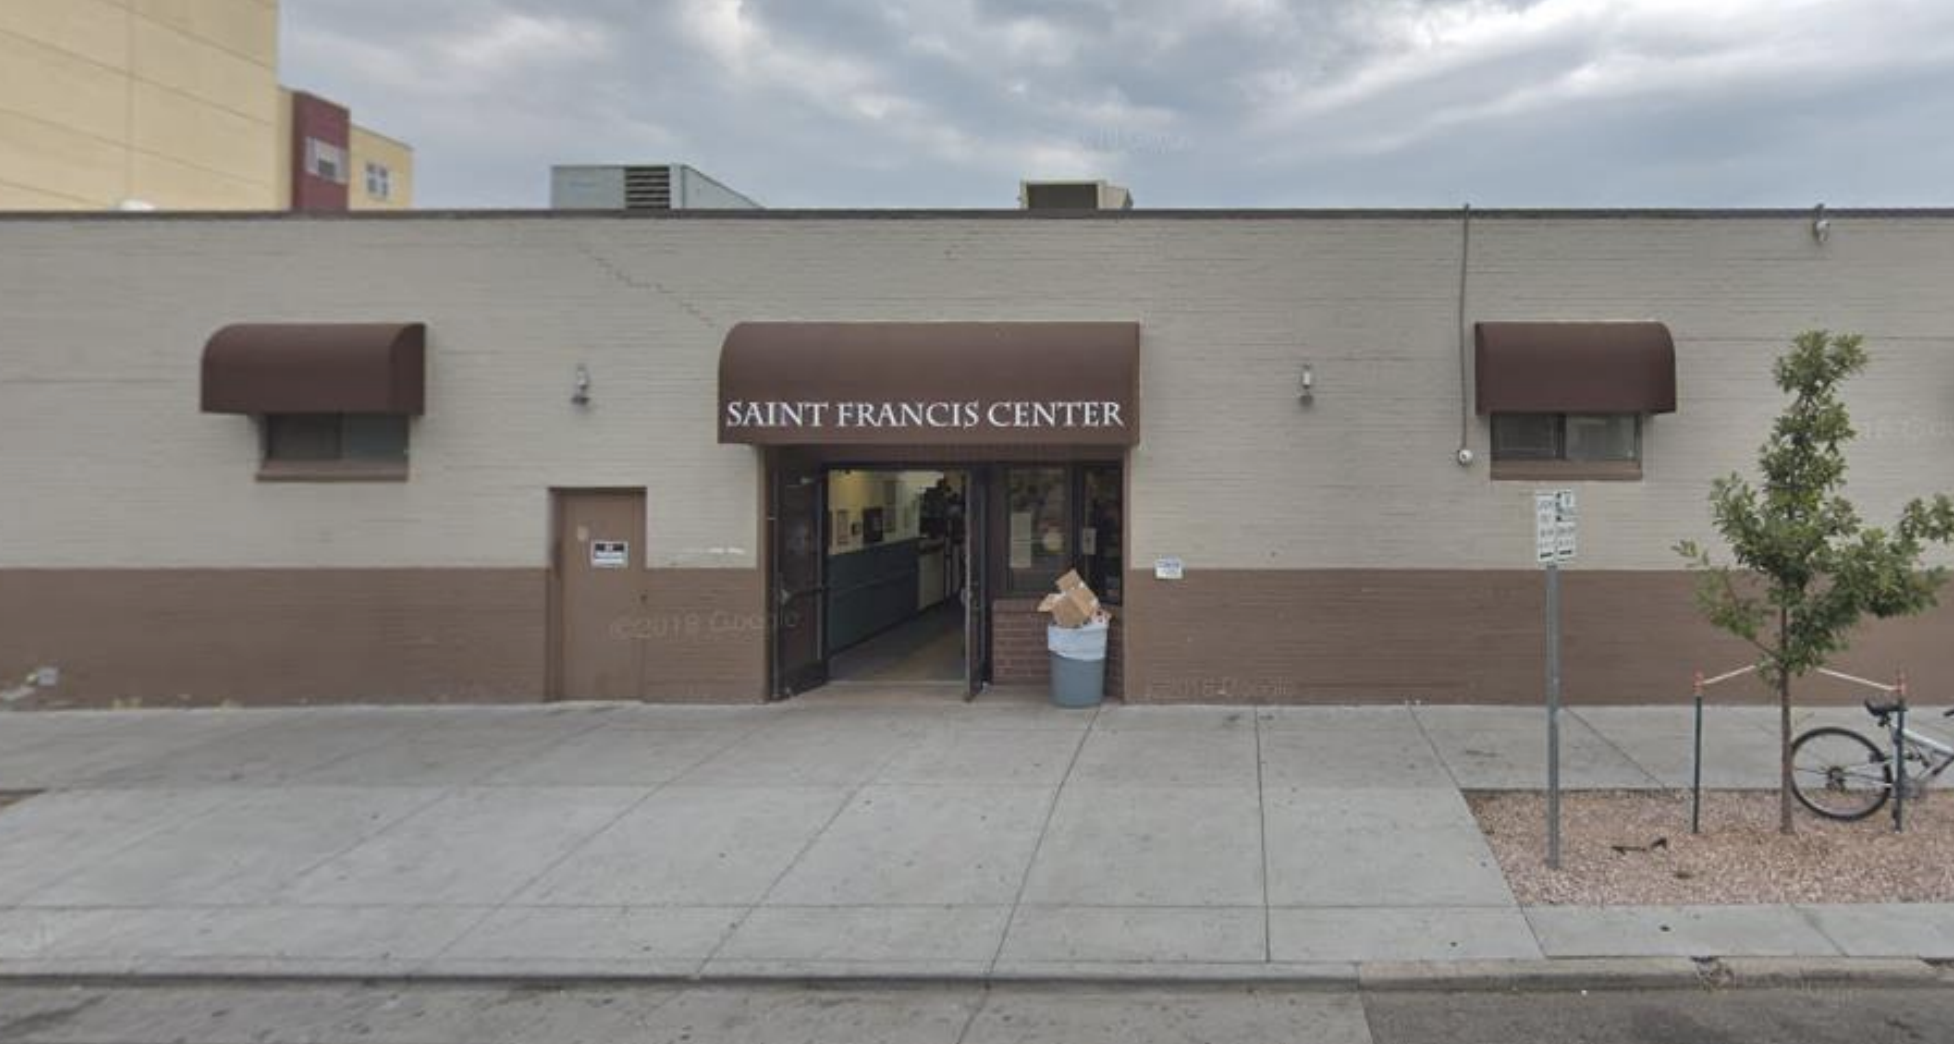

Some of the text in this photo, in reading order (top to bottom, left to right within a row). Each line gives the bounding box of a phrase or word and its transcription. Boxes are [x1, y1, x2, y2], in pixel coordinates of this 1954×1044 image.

[726, 400, 1124, 429] SAINT FRANCIS CENTER
